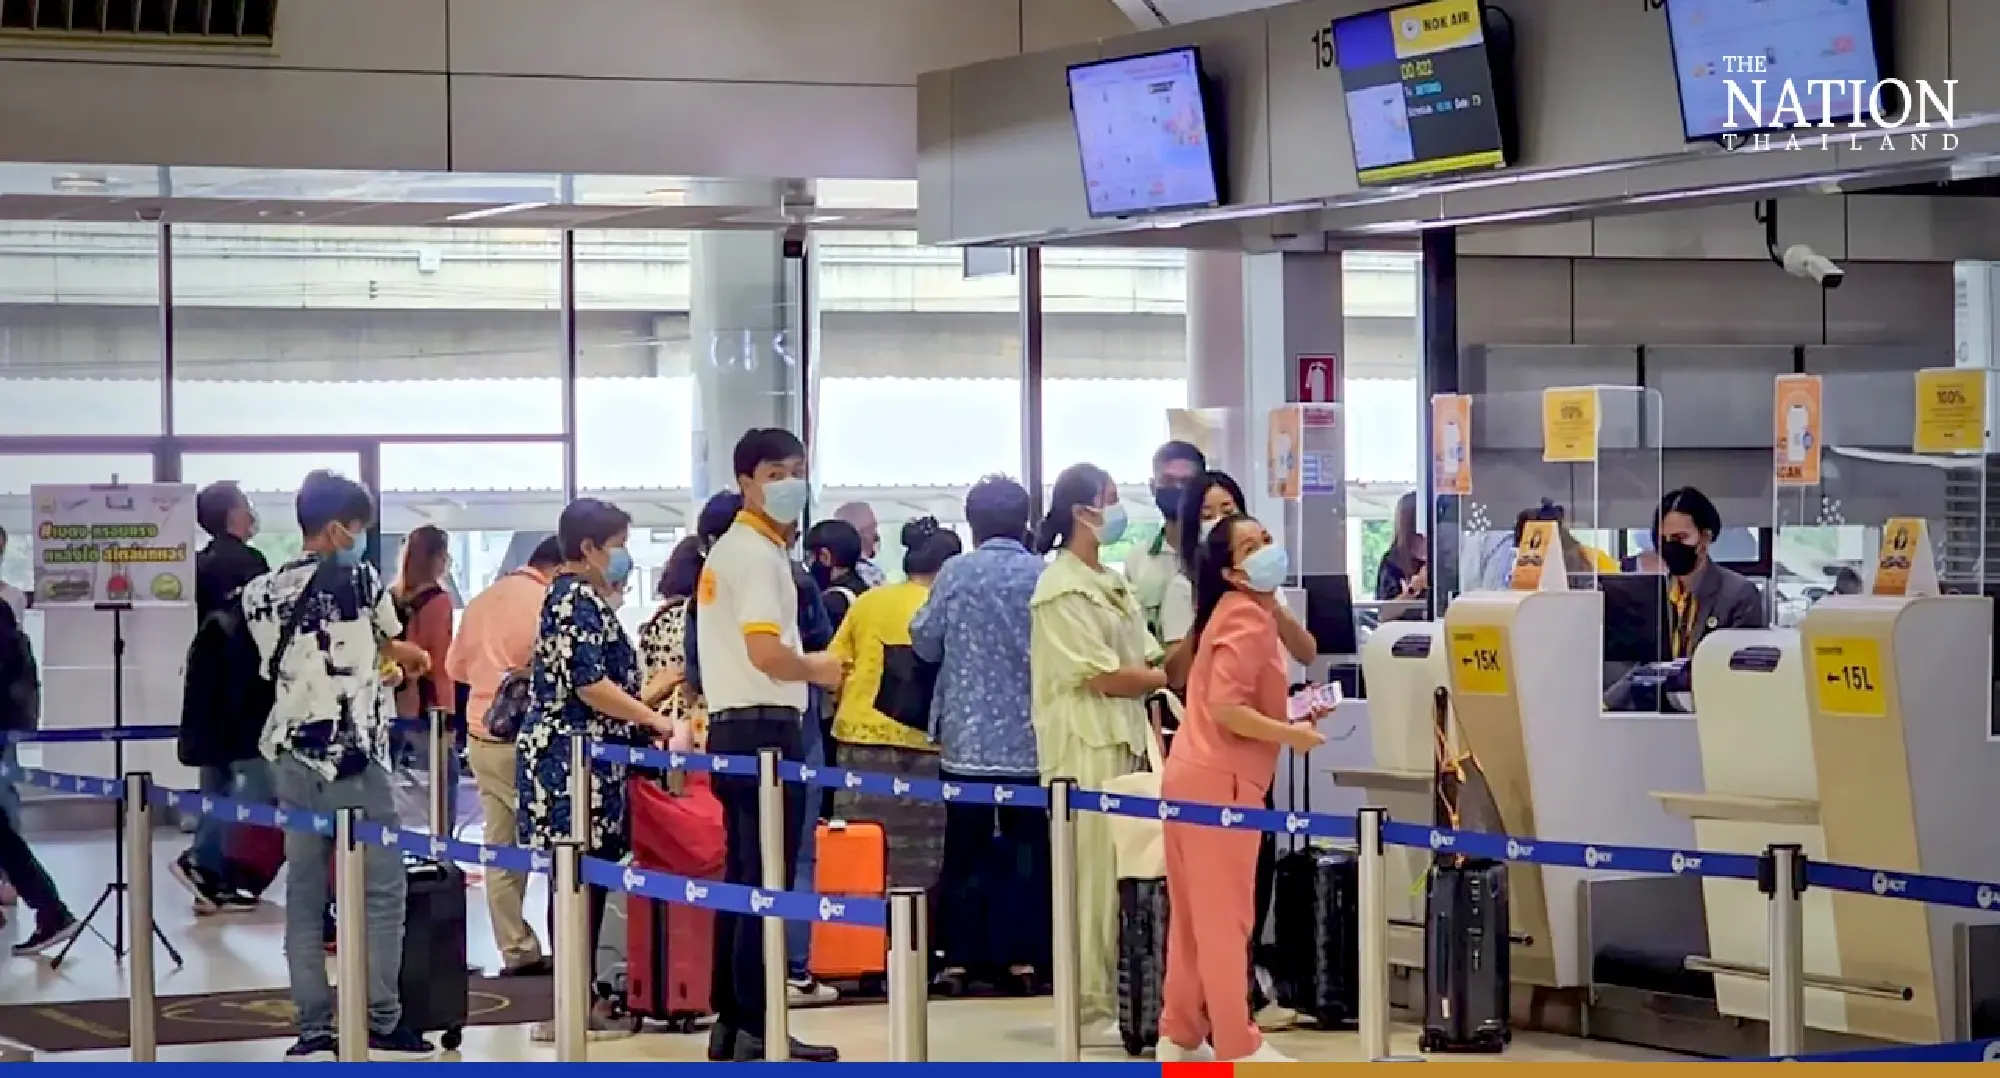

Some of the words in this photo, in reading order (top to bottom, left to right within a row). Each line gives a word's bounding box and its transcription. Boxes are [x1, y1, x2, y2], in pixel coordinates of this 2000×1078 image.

[1423, 17, 1448, 32] NOK
[1451, 11, 1471, 26] AIR
[1474, 649, 1501, 672] 15K
[1841, 665, 1874, 692] 15L
